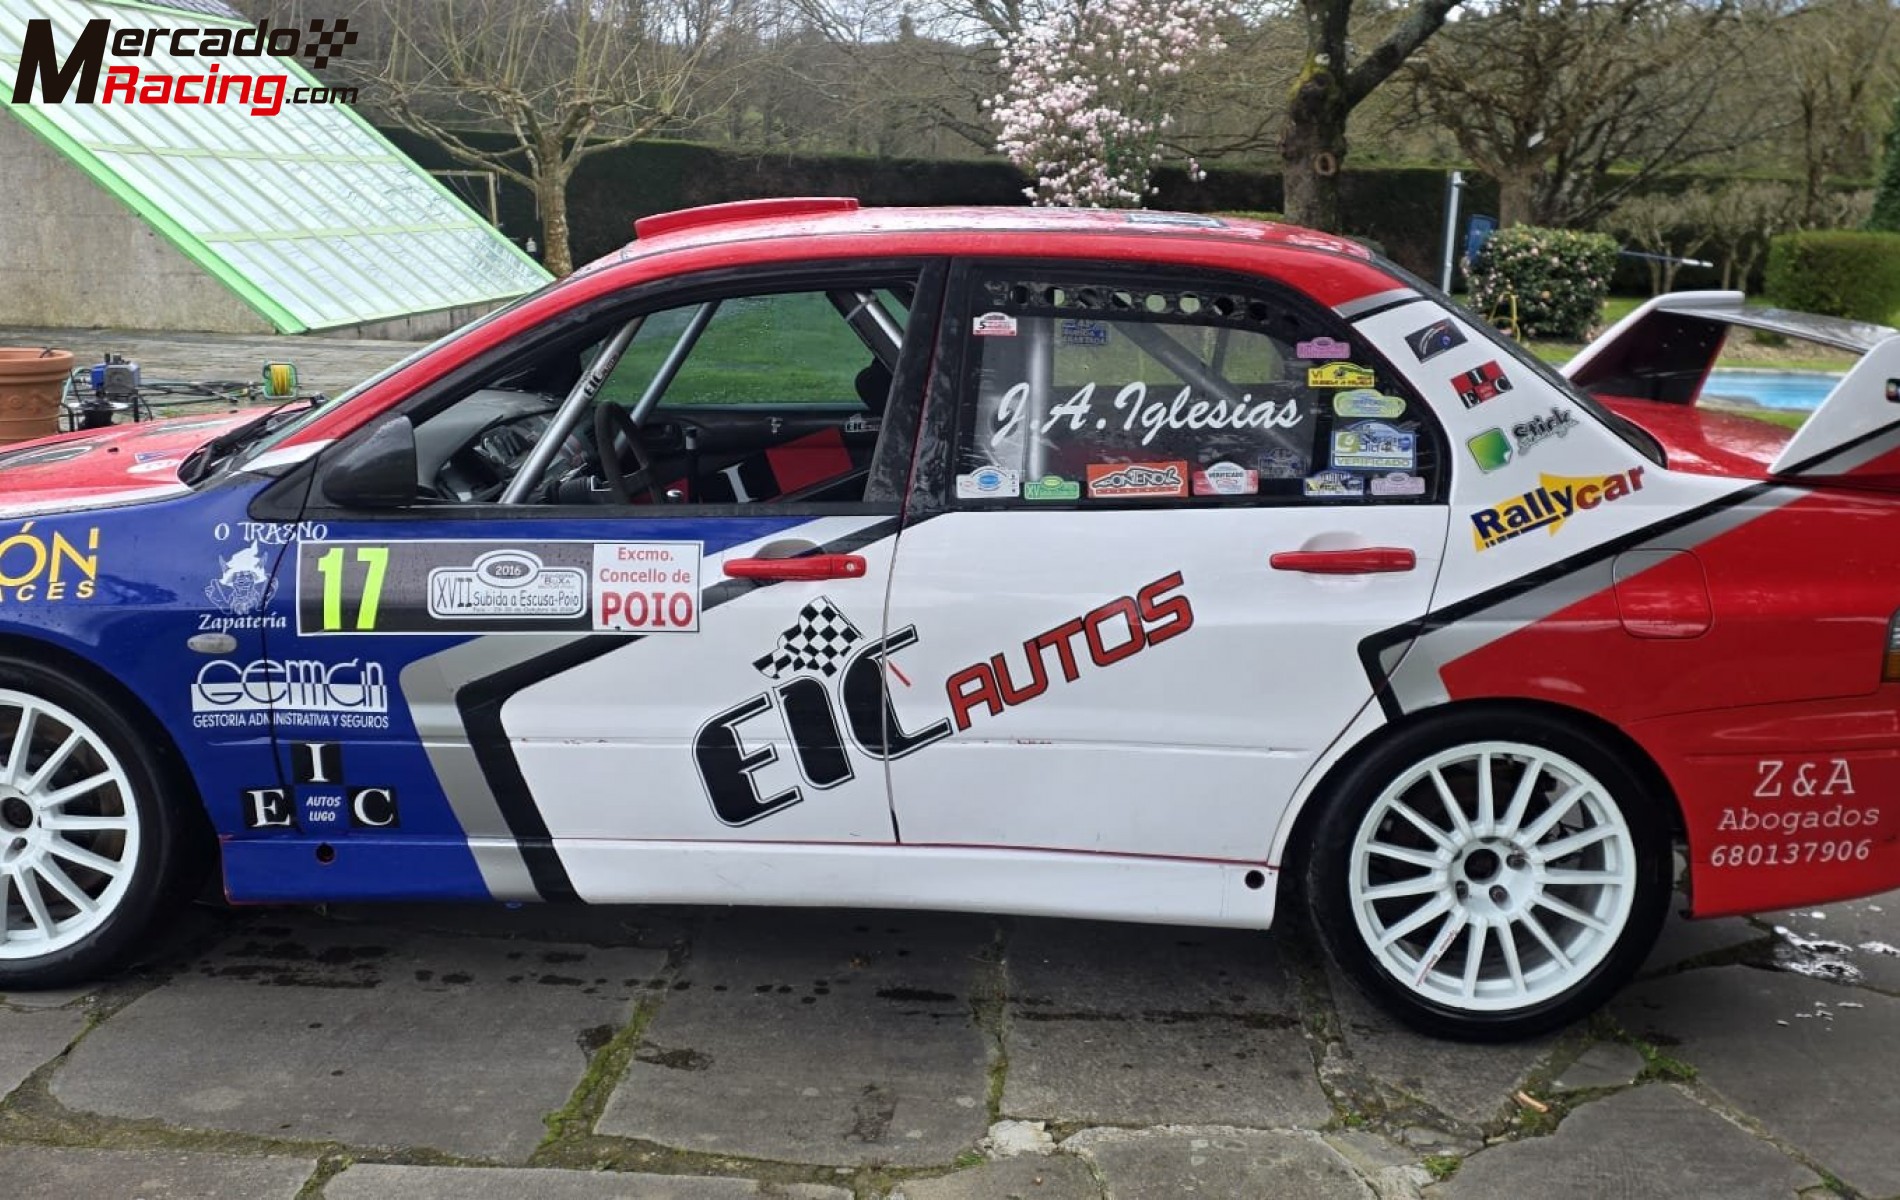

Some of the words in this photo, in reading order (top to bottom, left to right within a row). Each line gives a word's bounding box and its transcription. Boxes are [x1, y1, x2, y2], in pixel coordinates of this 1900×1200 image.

[1471, 466, 1645, 540] Rallycar
[214, 522, 230, 541] O
[618, 547, 674, 560] Excmo.
[495, 565, 522, 576] 2016
[600, 568, 667, 583] Concello
[672, 568, 690, 583] de
[317, 547, 389, 630] 17
[473, 591, 508, 607] Subida
[602, 591, 693, 627] POIO
[198, 612, 287, 634] Zapatería
[691, 622, 954, 828] EIC
[945, 570, 1195, 733] AUTOS
[193, 713, 246, 728] GESTORIA
[330, 714, 340, 727] Y
[340, 715, 389, 729] SEGUROS
[305, 796, 342, 808] AUTOS
[309, 810, 337, 822] LUGO
[1717, 805, 1880, 836] Abogados
[1710, 839, 1873, 867] 680137906
